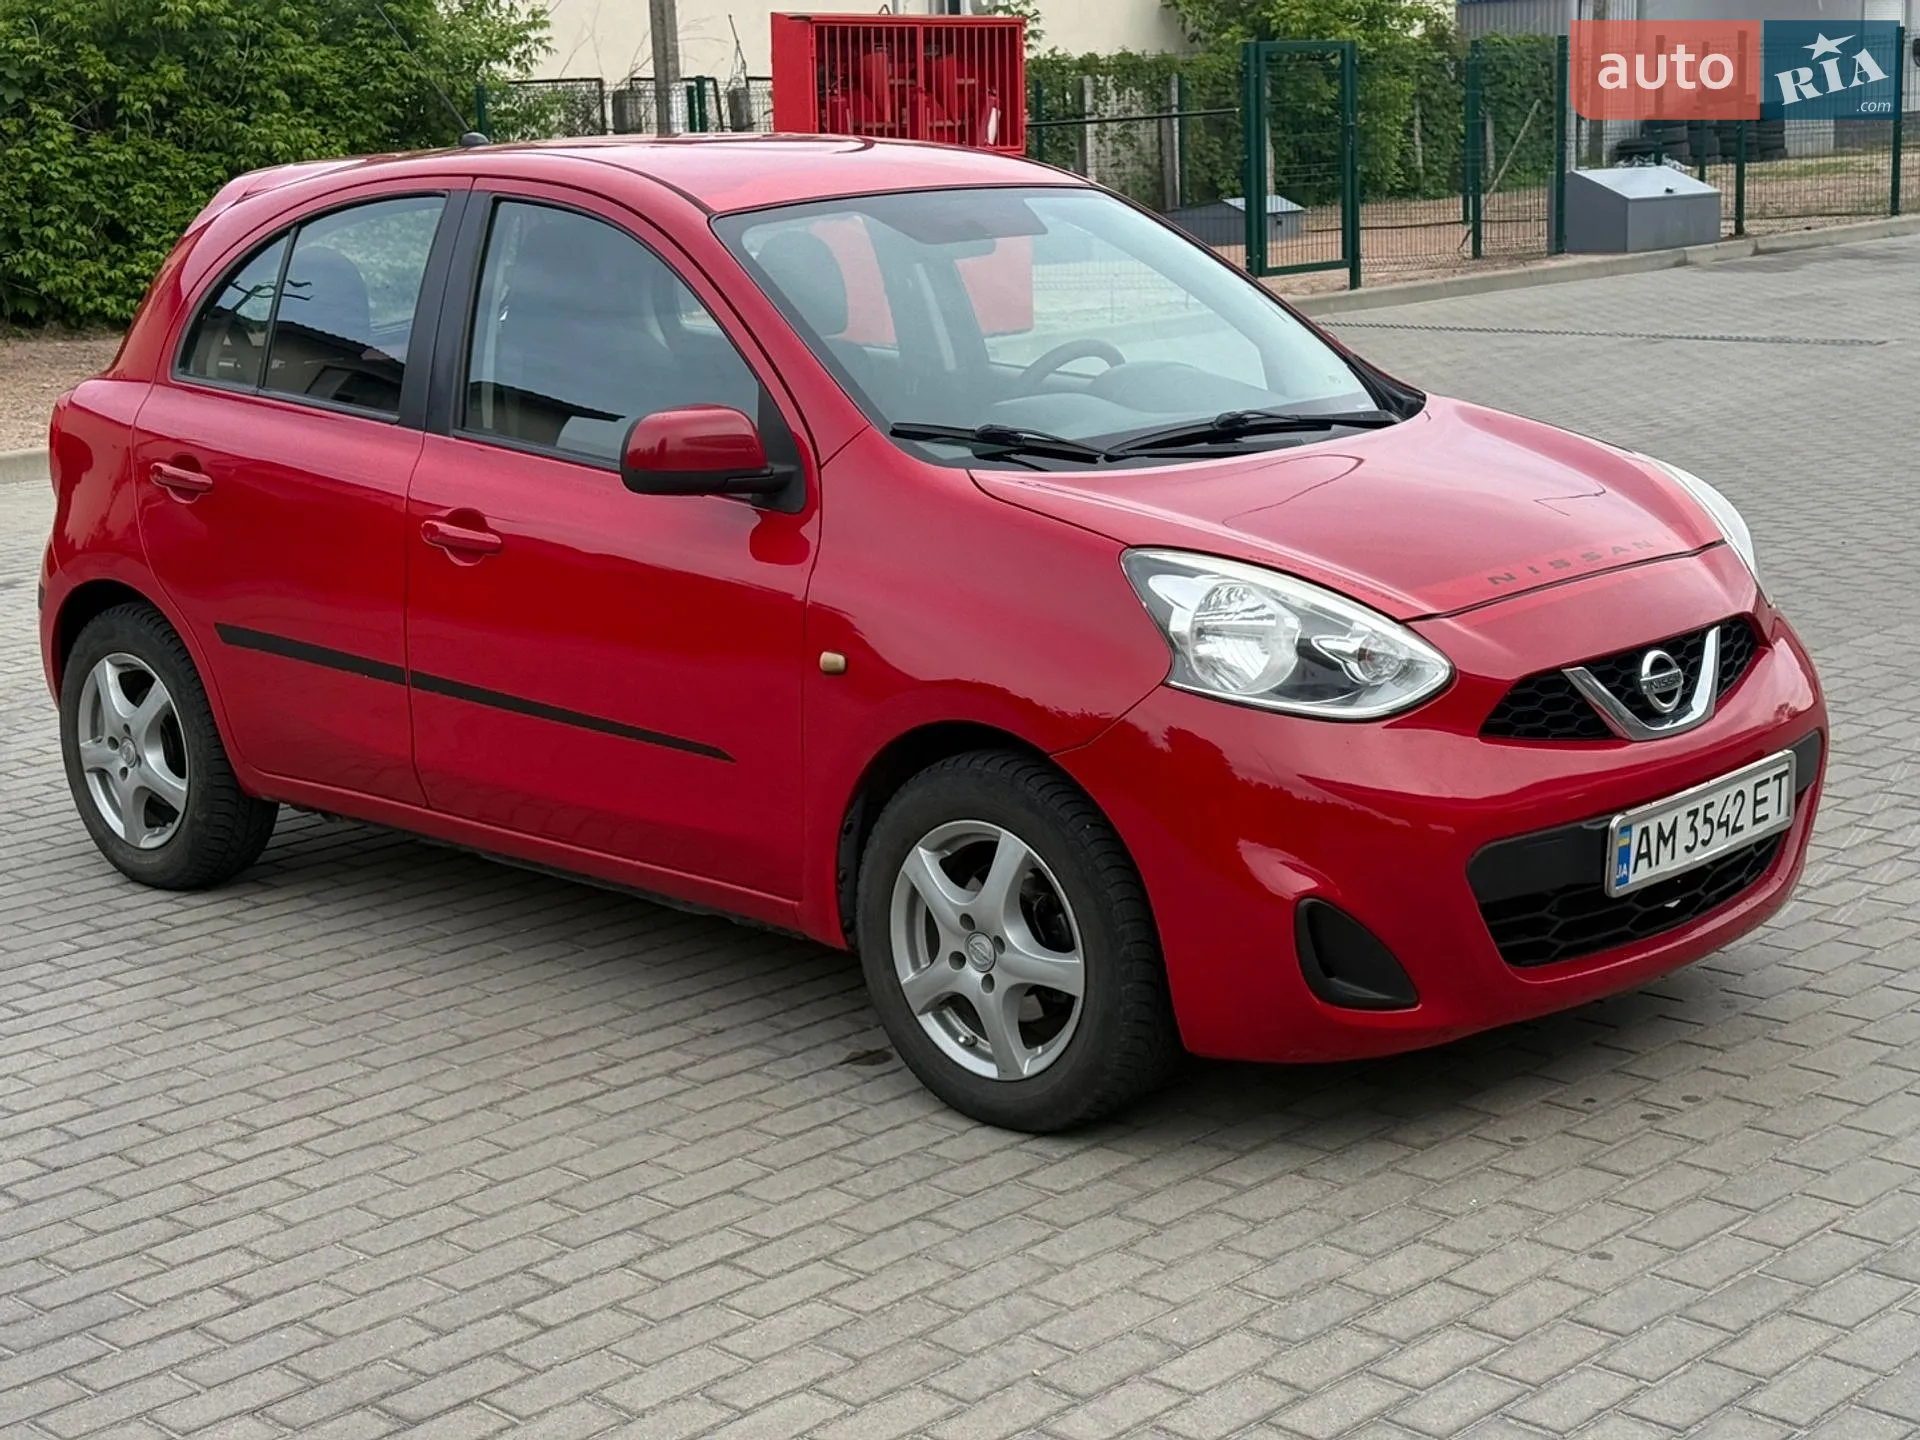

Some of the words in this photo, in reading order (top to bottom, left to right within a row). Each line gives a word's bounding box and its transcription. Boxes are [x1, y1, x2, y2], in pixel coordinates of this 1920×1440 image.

[1487, 538, 1655, 587] NISSAN
[1632, 815, 1679, 875] AM
[1684, 789, 1746, 854] 3542
[1752, 769, 1789, 826] ET
